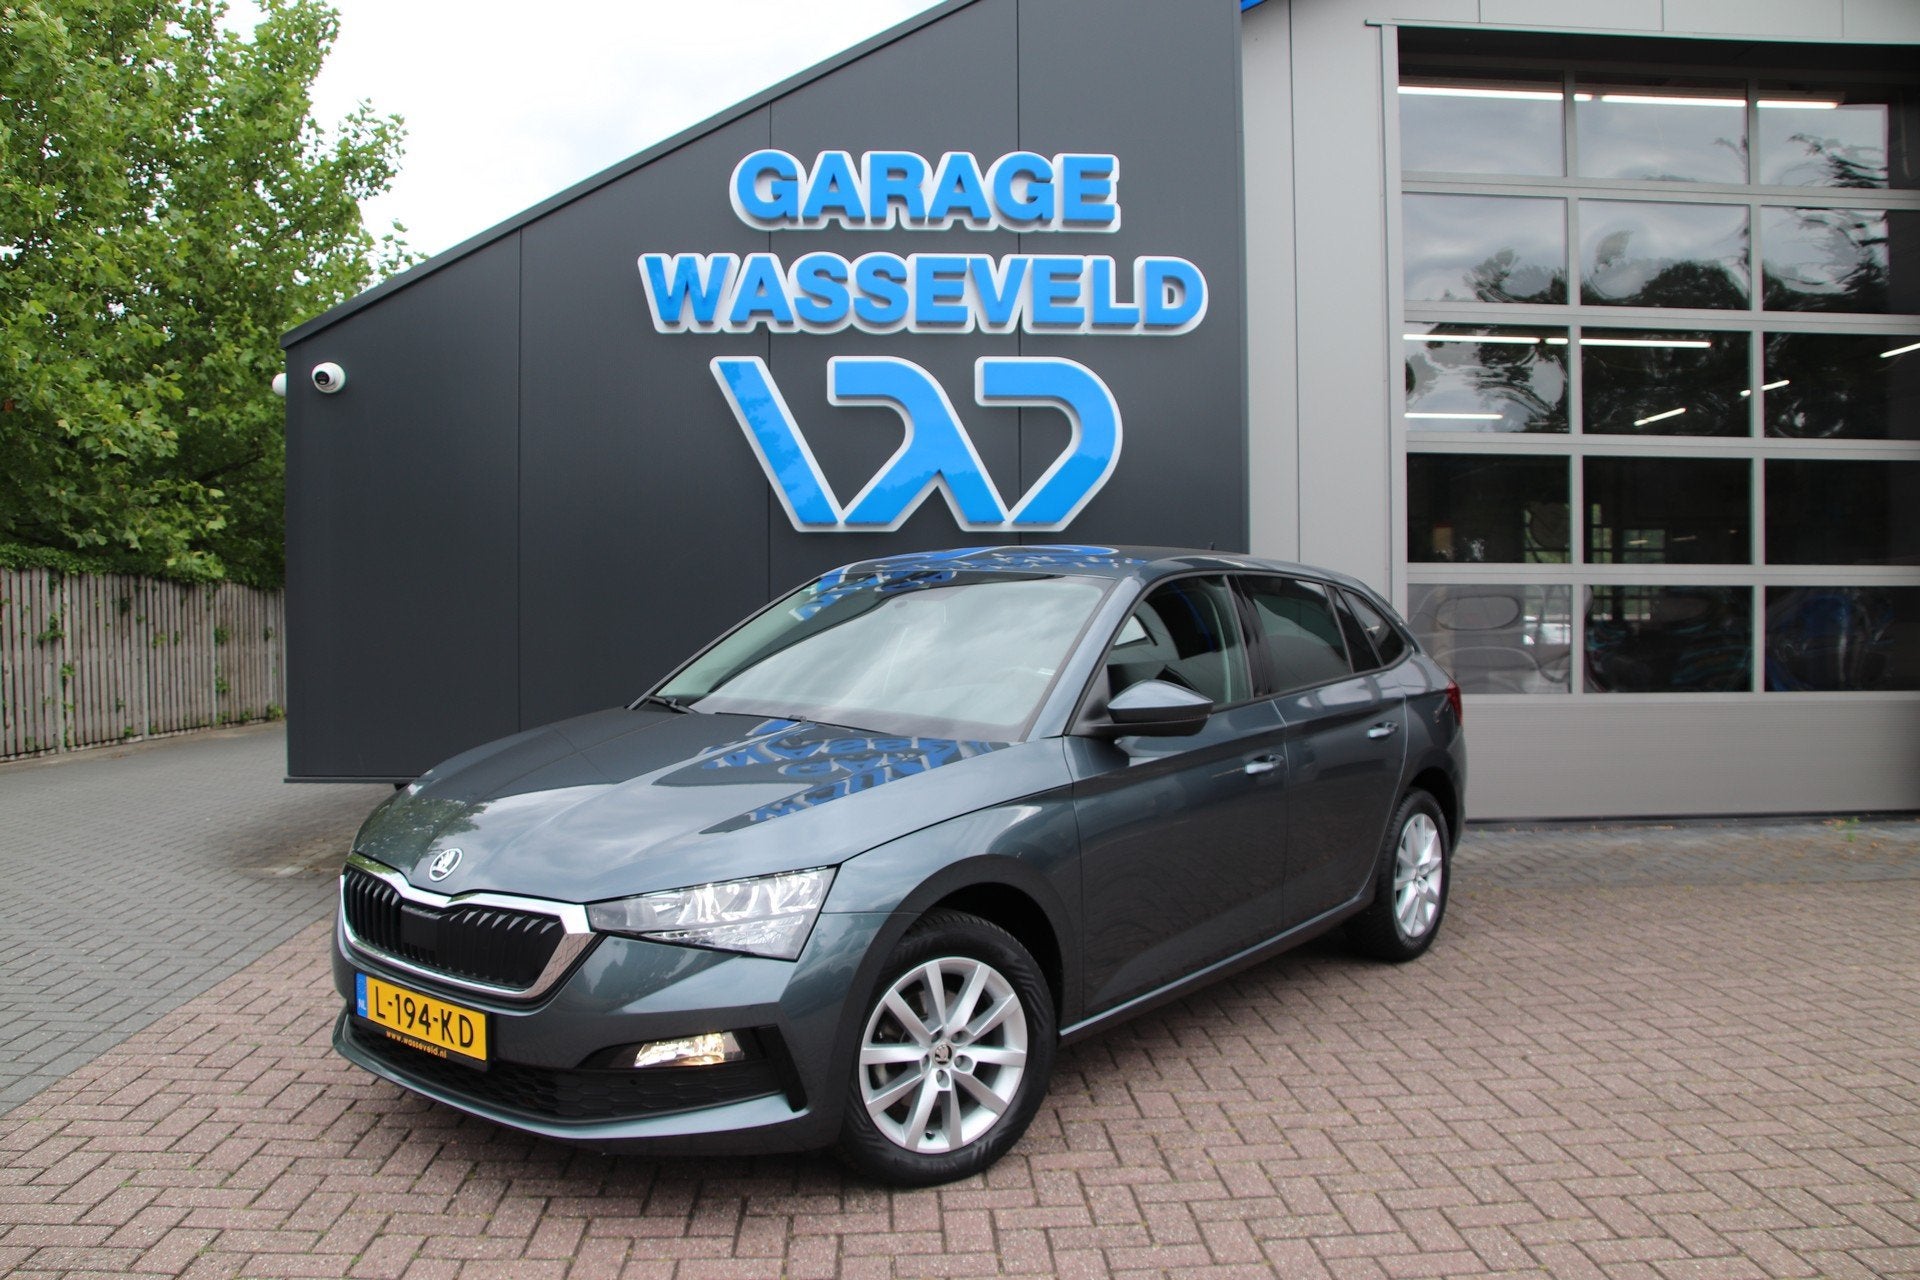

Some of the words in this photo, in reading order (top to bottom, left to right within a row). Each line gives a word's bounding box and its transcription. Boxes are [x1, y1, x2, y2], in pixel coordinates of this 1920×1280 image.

[733, 150, 1118, 228] GARAGE
[641, 253, 1206, 330] WASSEVELD
[375, 985, 474, 1048] L-194-KD
